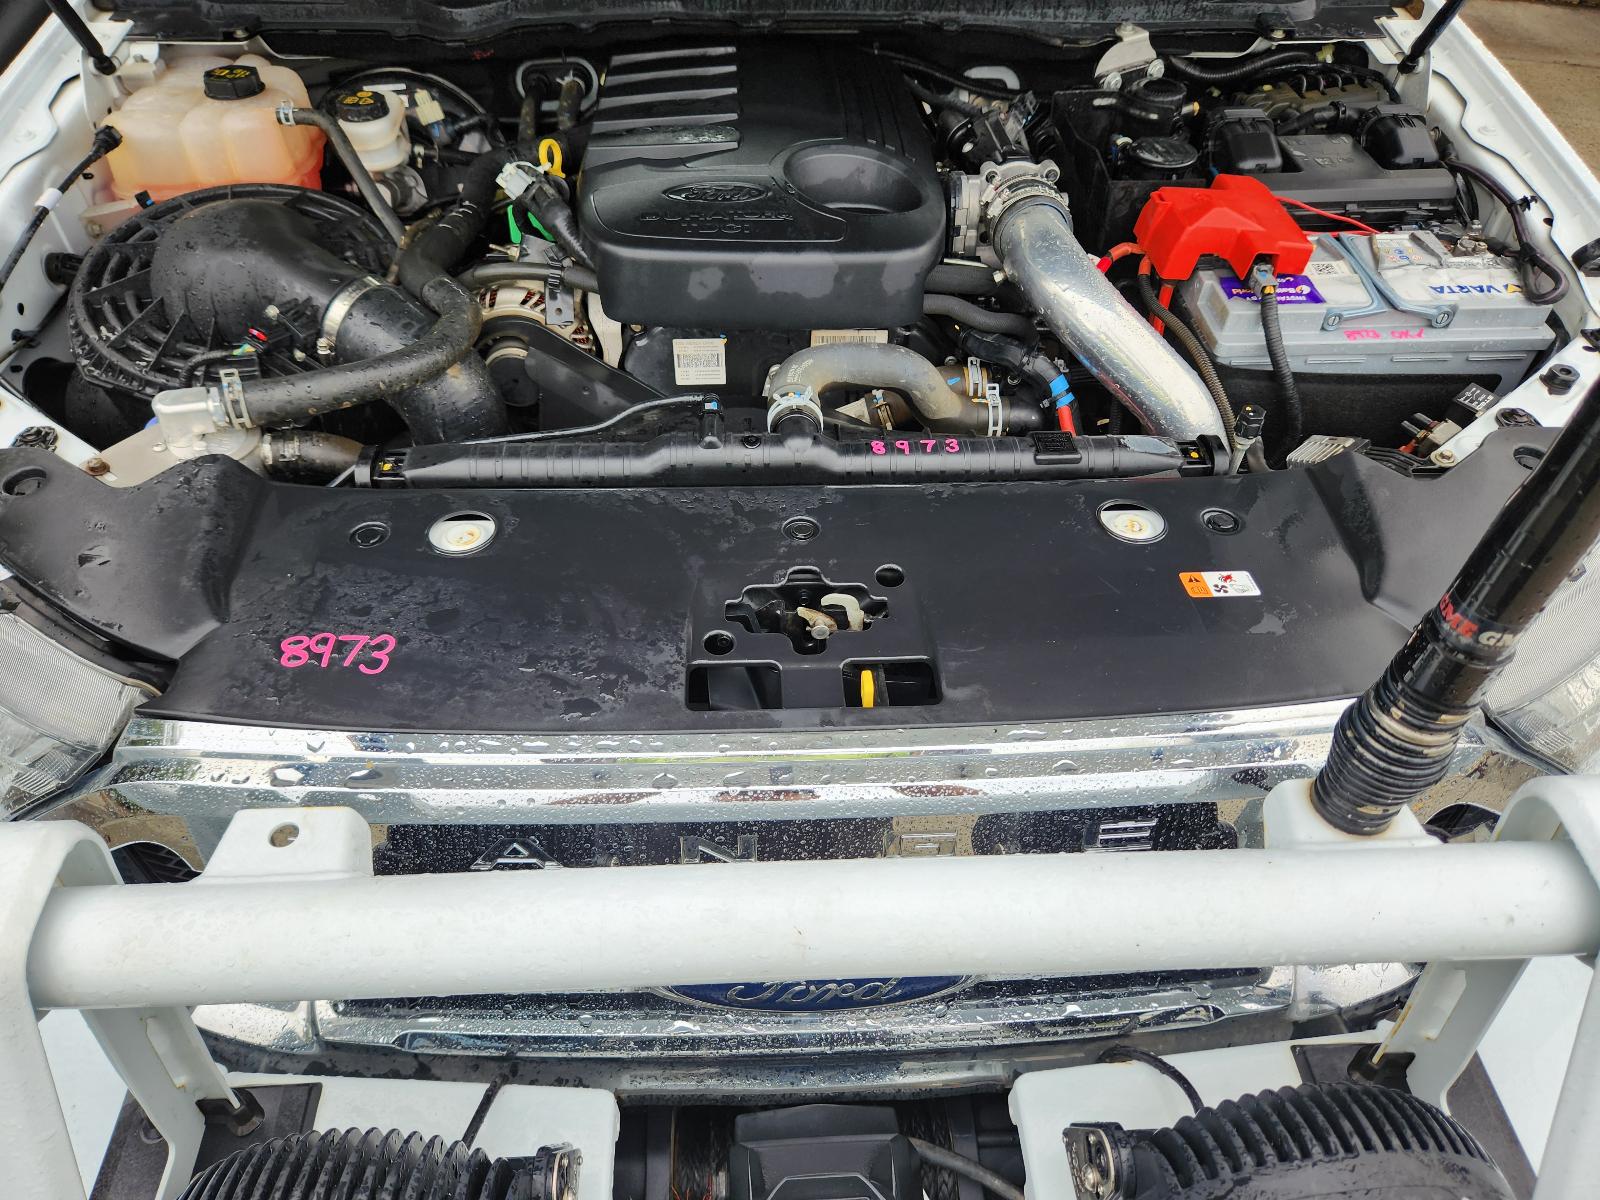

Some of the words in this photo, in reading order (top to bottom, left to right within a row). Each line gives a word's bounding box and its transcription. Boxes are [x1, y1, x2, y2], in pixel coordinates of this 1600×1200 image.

[684, 183, 770, 201] Ford
[1429, 284, 1502, 294] VARTA
[871, 439, 959, 455] 8973
[1479, 631, 1520, 648] GM
[280, 632, 396, 675] 8973
[727, 978, 903, 1003] Ford
